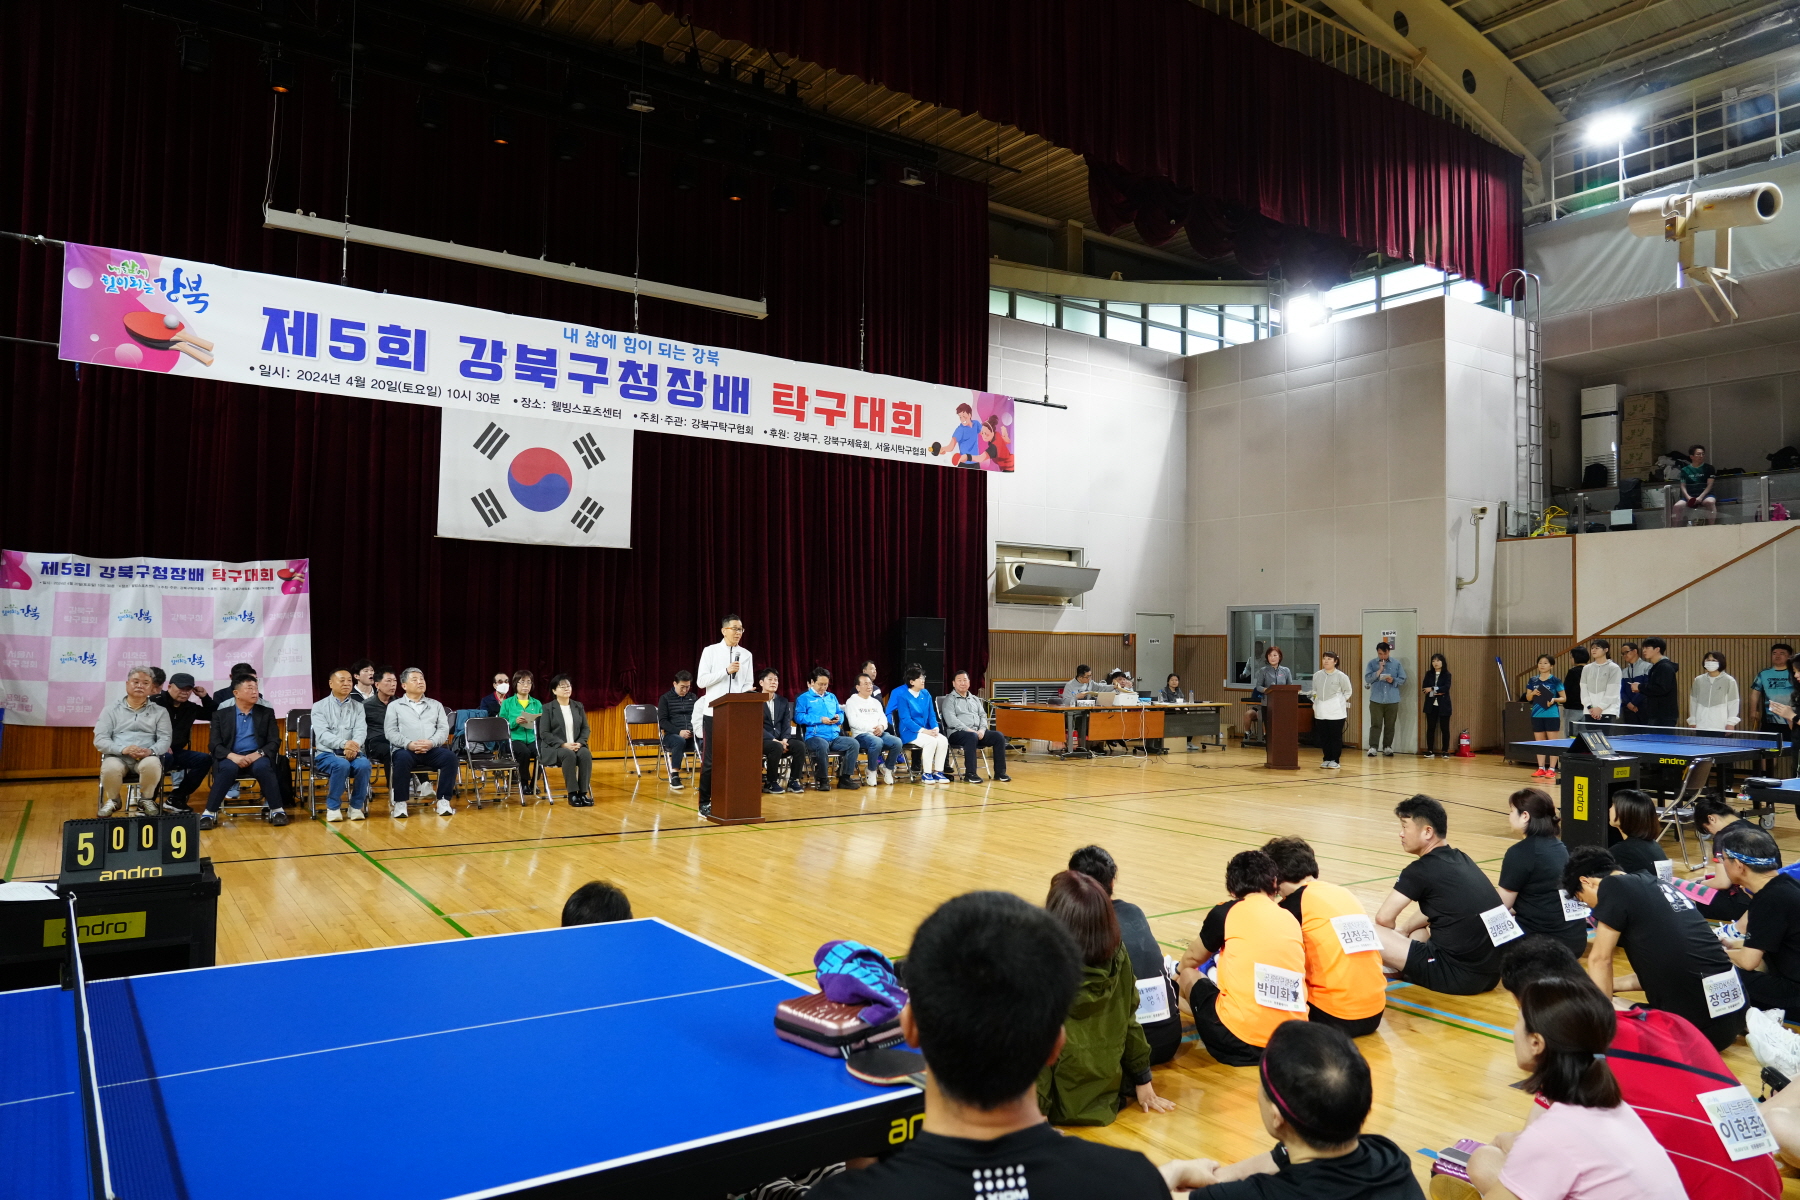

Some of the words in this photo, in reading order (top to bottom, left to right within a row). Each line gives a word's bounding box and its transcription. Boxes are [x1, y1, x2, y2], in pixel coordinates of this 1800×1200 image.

[154, 267, 209, 314] 강북
[563, 327, 579, 344] 내
[585, 330, 617, 350] 삶에
[623, 335, 652, 355] 힘이
[658, 342, 686, 362] 되는
[692, 347, 720, 368] 강북
[261, 306, 427, 373] 제5회
[459, 335, 750, 415] 강북구청장배
[772, 382, 922, 438] 탁구대회
[297, 370, 341, 386] 2024년
[346, 375, 366, 389] 4월
[371, 378, 442, 398] 20일(토요일)
[447, 388, 472, 402] 10시
[476, 391, 501, 405] 30분
[551, 400, 622, 420] 웰빙스포츠센터
[691, 418, 754, 436] 강북구탁구협회
[875, 441, 927, 458] 서울시탁구협회
[40, 561, 91, 578] 제5회
[99, 563, 204, 582] 강북구청장배
[212, 568, 273, 583] 탁구대회
[20, 604, 40, 621] 강북
[134, 608, 152, 624] 강북
[238, 610, 255, 624] 강북
[78, 651, 97, 667] 강북
[187, 653, 205, 668] 강북
[1659, 757, 1686, 766] andro
[1576, 783, 1584, 812] andro
[77, 832, 95, 866] 5
[112, 826, 124, 850] 0
[141, 824, 154, 849] 0
[170, 826, 187, 859] 9
[99, 865, 163, 881] andro
[1257, 981, 1290, 1001] 박미화
